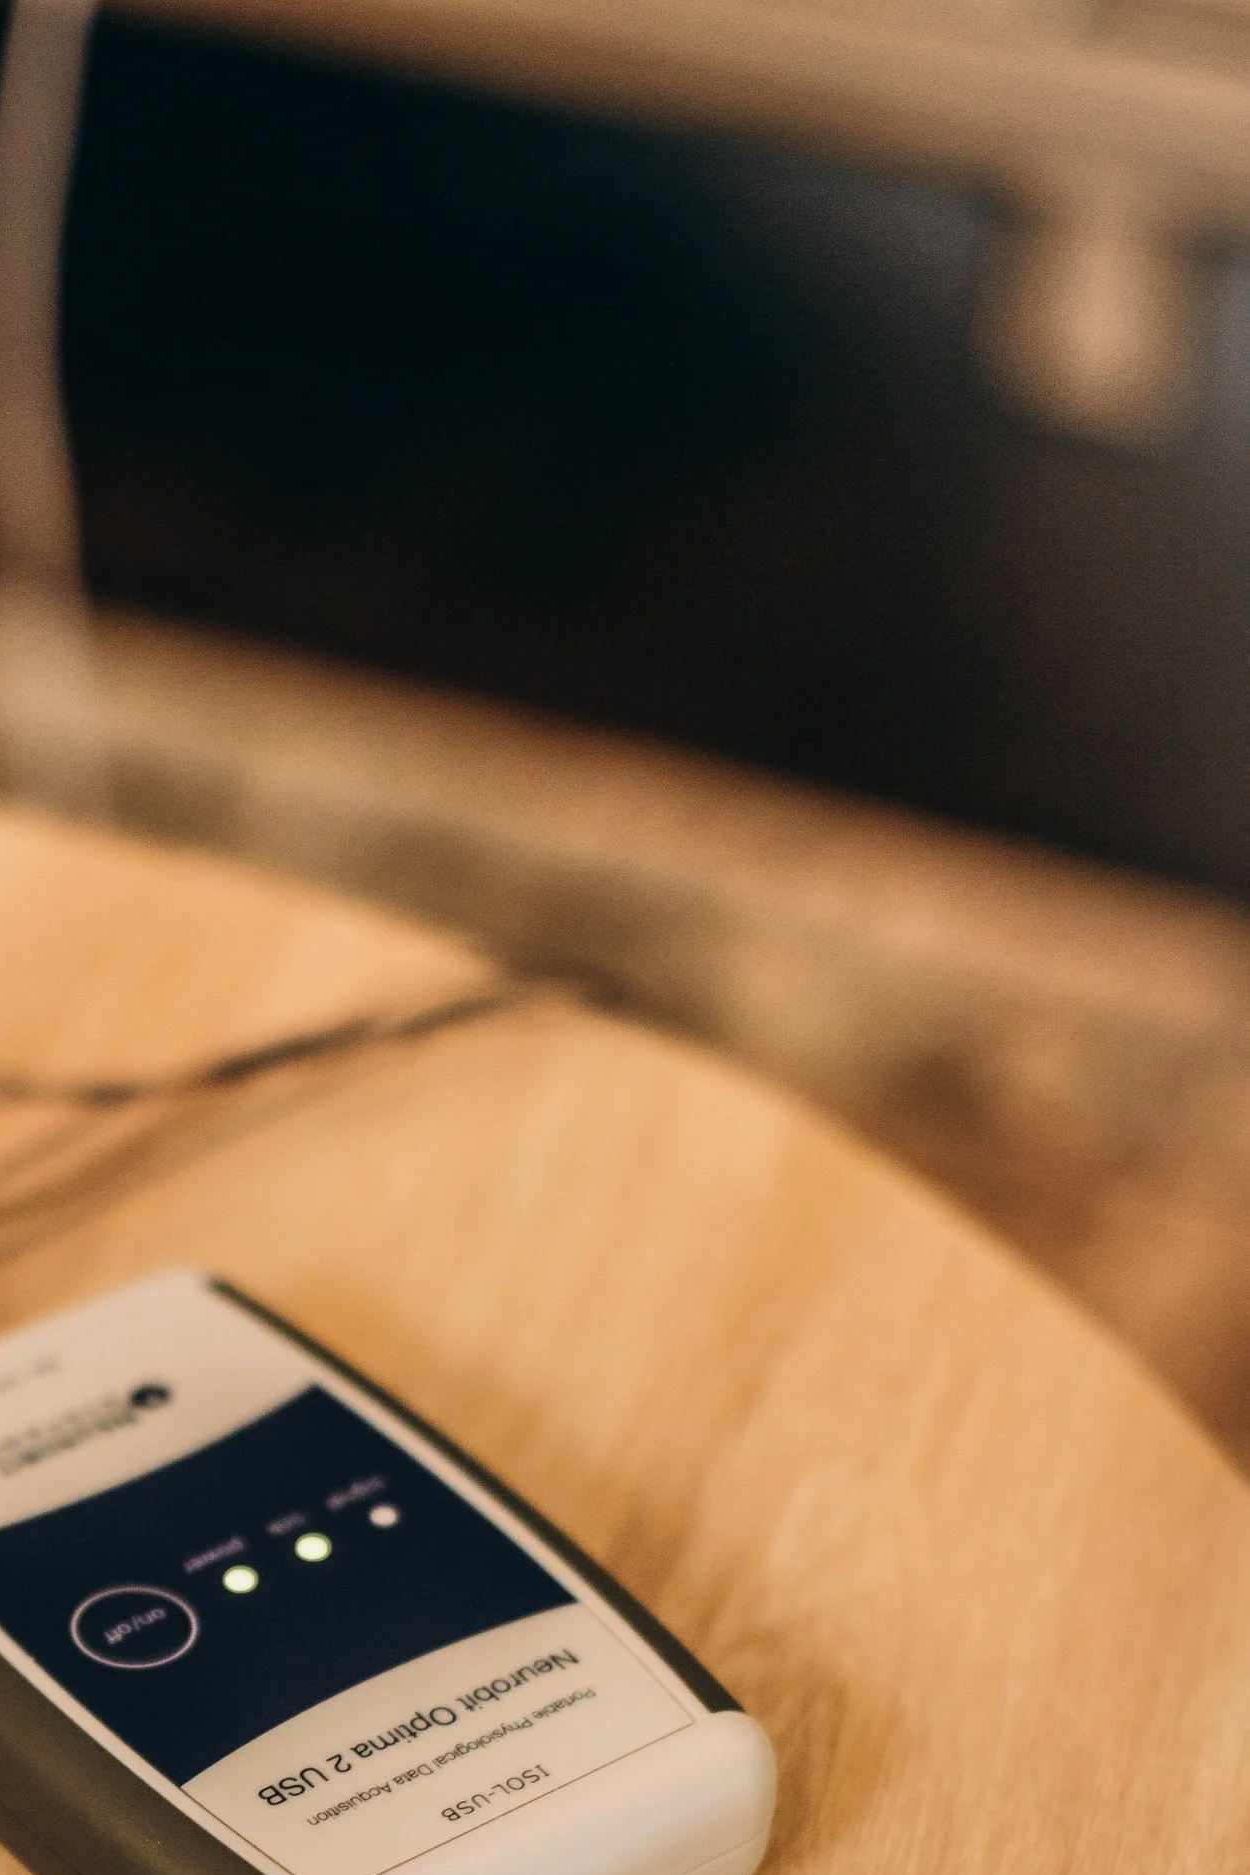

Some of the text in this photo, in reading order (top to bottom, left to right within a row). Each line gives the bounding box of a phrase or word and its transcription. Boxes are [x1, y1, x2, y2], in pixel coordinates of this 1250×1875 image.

[104, 1607, 166, 1645] on/off
[258, 1649, 580, 1806] Neurobit Optima 2 USB
[306, 1687, 597, 1826] Portable Physiological Data Acquisition
[442, 1763, 551, 1821] ISOL-USB
